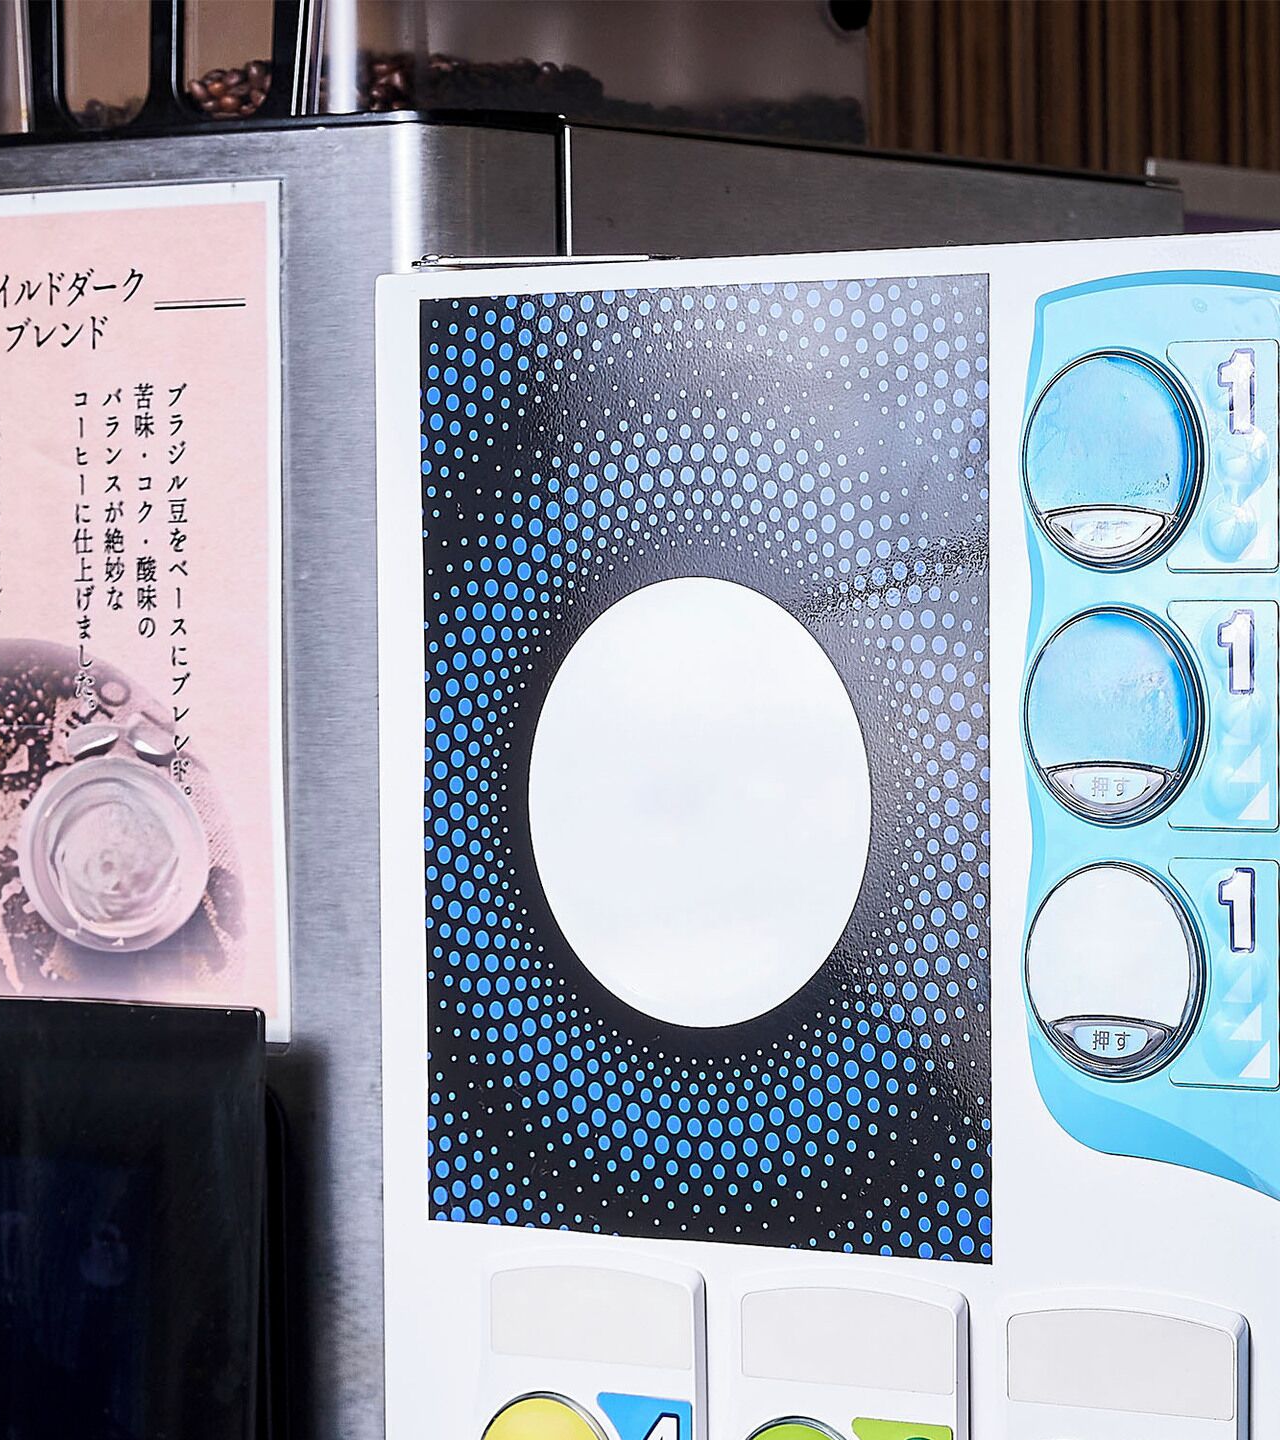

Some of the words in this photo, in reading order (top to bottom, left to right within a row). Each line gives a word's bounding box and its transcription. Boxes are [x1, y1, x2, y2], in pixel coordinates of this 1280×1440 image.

[5, 315, 108, 353] ブレンド
[1217, 347, 1256, 435] 1
[102, 388, 125, 611] バランスが絶妙な
[133, 383, 158, 639] 苦味・コク・酸味の
[72, 390, 98, 712] コーヒーに仕上げました。
[167, 383, 193, 797] ブラジル豆をベースにブレンド。
[1217, 609, 1256, 695] 1
[1090, 775, 1133, 799] 押す
[1218, 867, 1255, 953] 1
[1091, 1029, 1131, 1052] 押す
